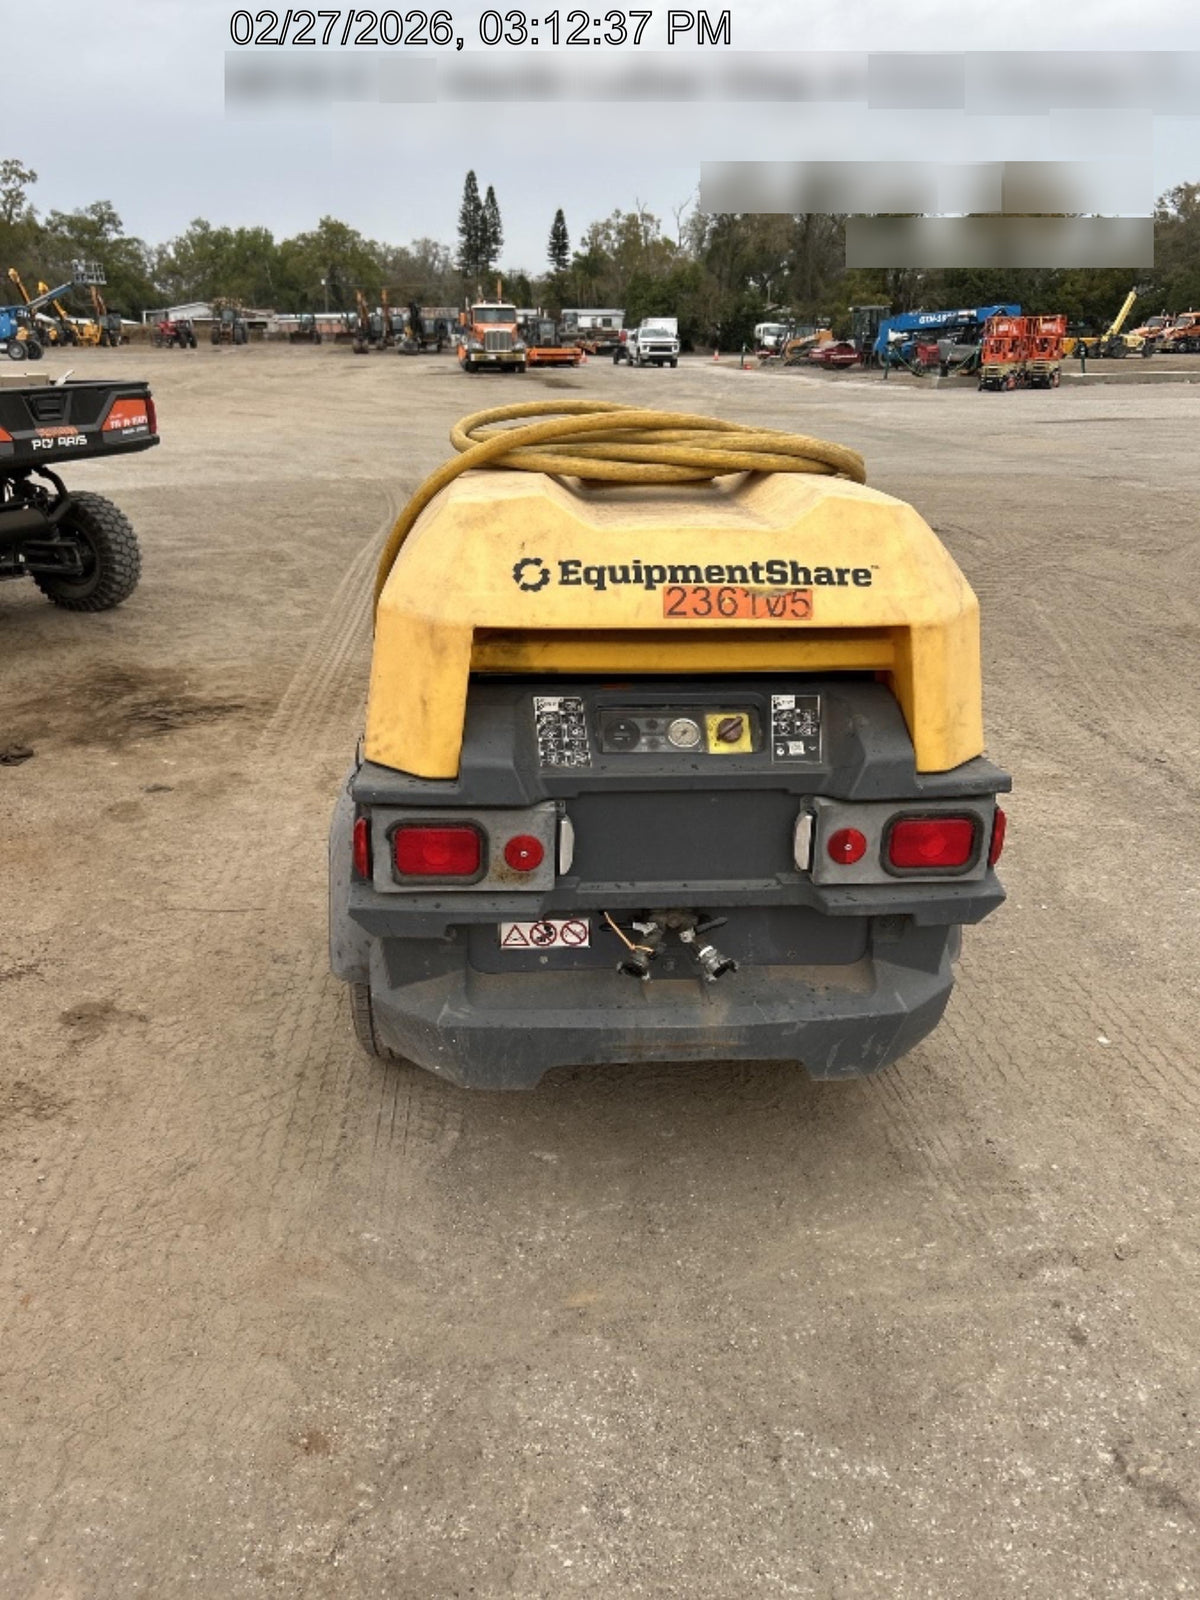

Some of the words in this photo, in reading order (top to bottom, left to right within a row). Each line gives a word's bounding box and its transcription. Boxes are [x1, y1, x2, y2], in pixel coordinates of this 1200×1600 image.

[31, 434, 88, 450] POARIS
[557, 559, 873, 591] EquipmentShare
[665, 585, 812, 618] 236105
